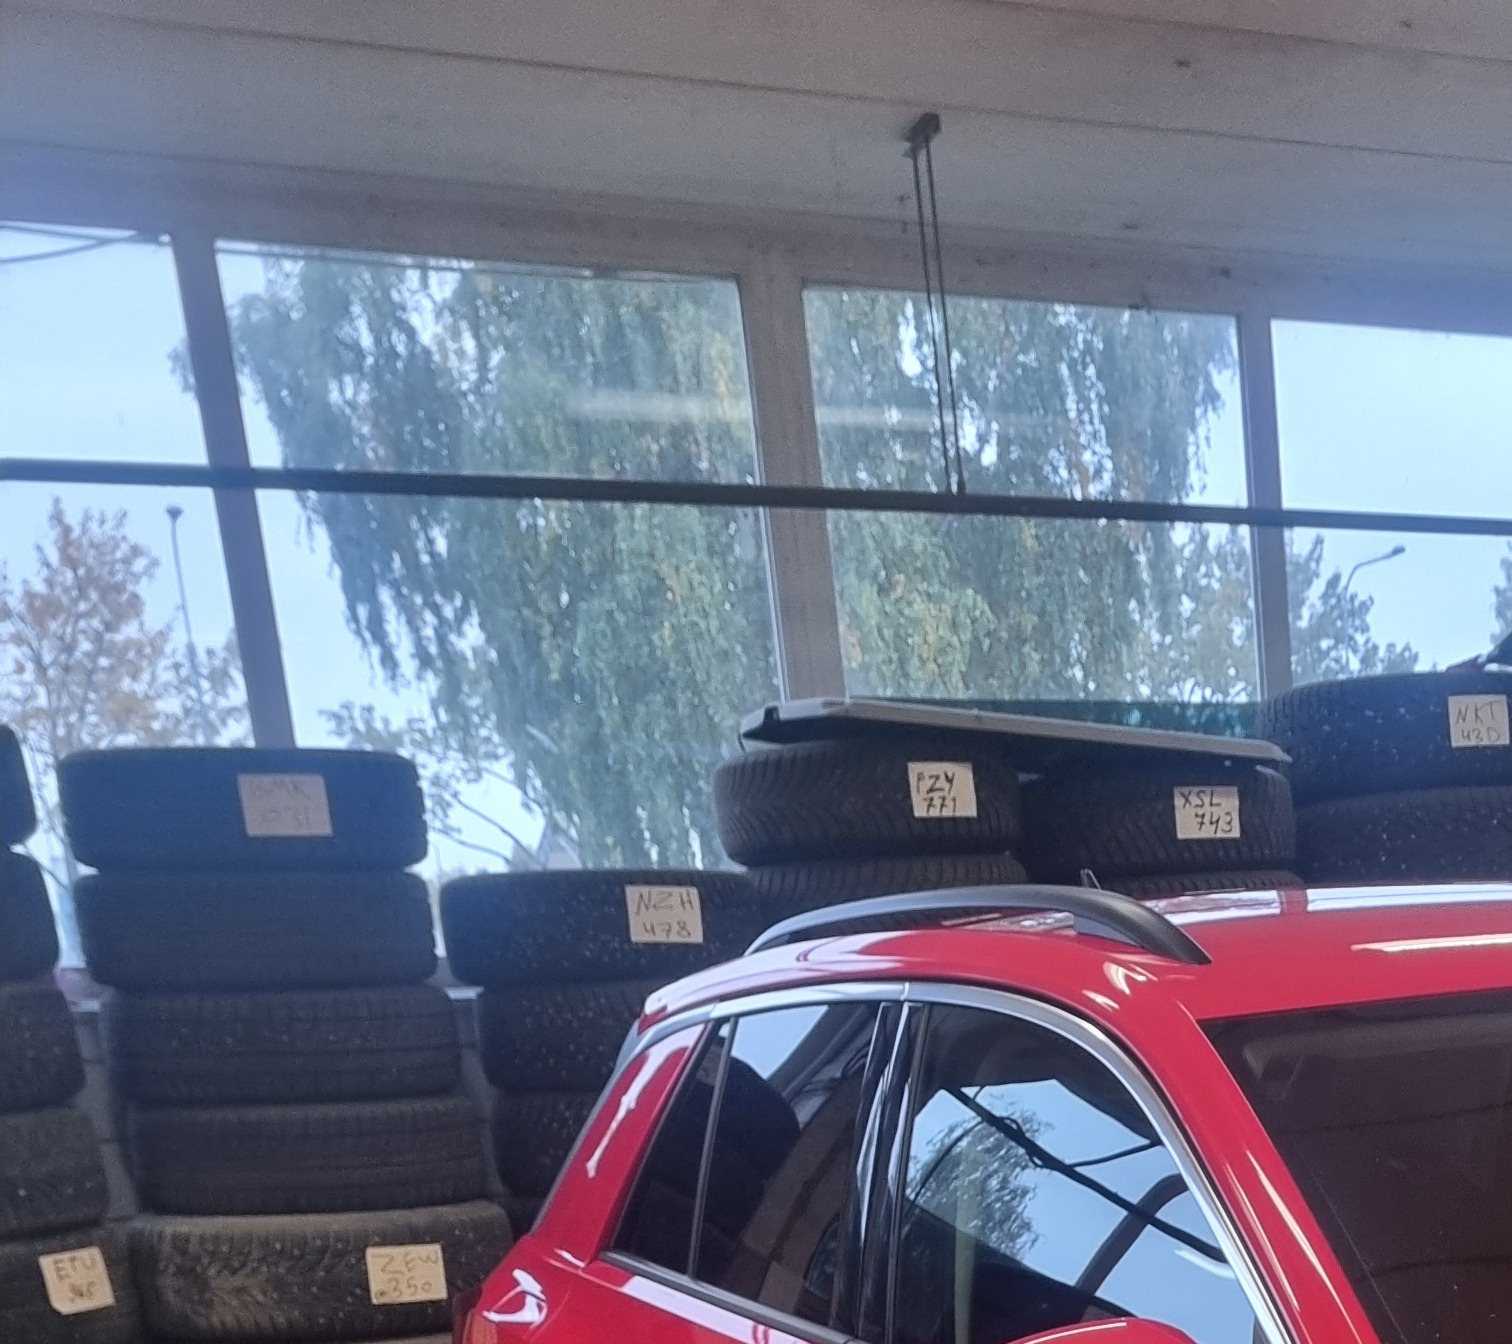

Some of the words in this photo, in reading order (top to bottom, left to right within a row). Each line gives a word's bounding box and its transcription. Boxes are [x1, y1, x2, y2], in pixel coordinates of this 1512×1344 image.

[1456, 701, 1500, 725] NKT
[924, 796, 956, 815] 771
[1180, 790, 1222, 809] XSL
[1195, 812, 1233, 834] 743
[636, 890, 694, 915] NZH
[643, 921, 692, 939] 478
